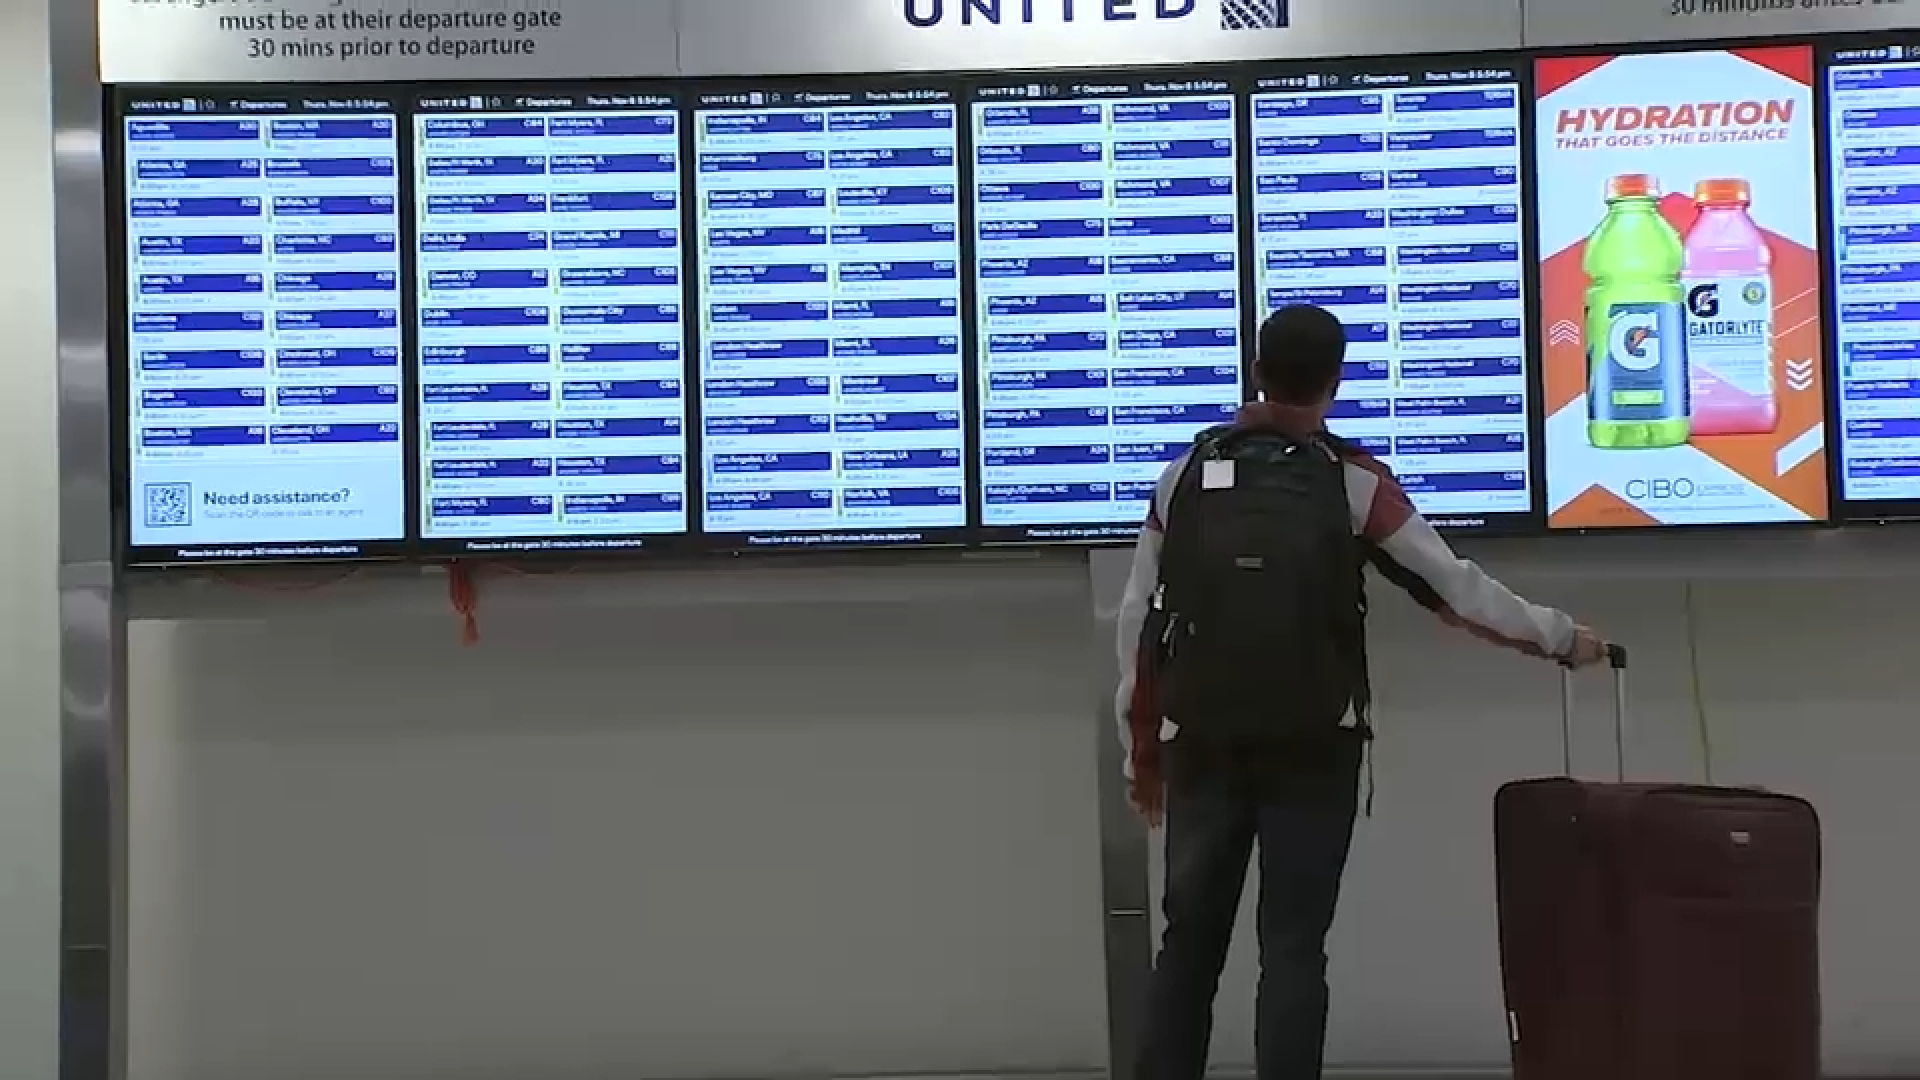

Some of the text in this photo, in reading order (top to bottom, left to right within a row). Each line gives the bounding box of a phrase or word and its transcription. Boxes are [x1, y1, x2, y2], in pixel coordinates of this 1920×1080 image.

[1672, 0, 1696, 15] 30
[219, 9, 561, 31] must be at their departure gate
[247, 36, 535, 61] 30 mins prior to departure
[1082, 85, 1128, 93] Departures
[1258, 78, 1304, 86] UNITED
[1556, 97, 1795, 133] HYDRATION
[1557, 128, 1788, 149] THAT GOES THE DISTANCE
[1690, 321, 1762, 336] GATORLYTE
[204, 488, 351, 504] Need assistance?
[1626, 478, 1695, 499] CIBO
